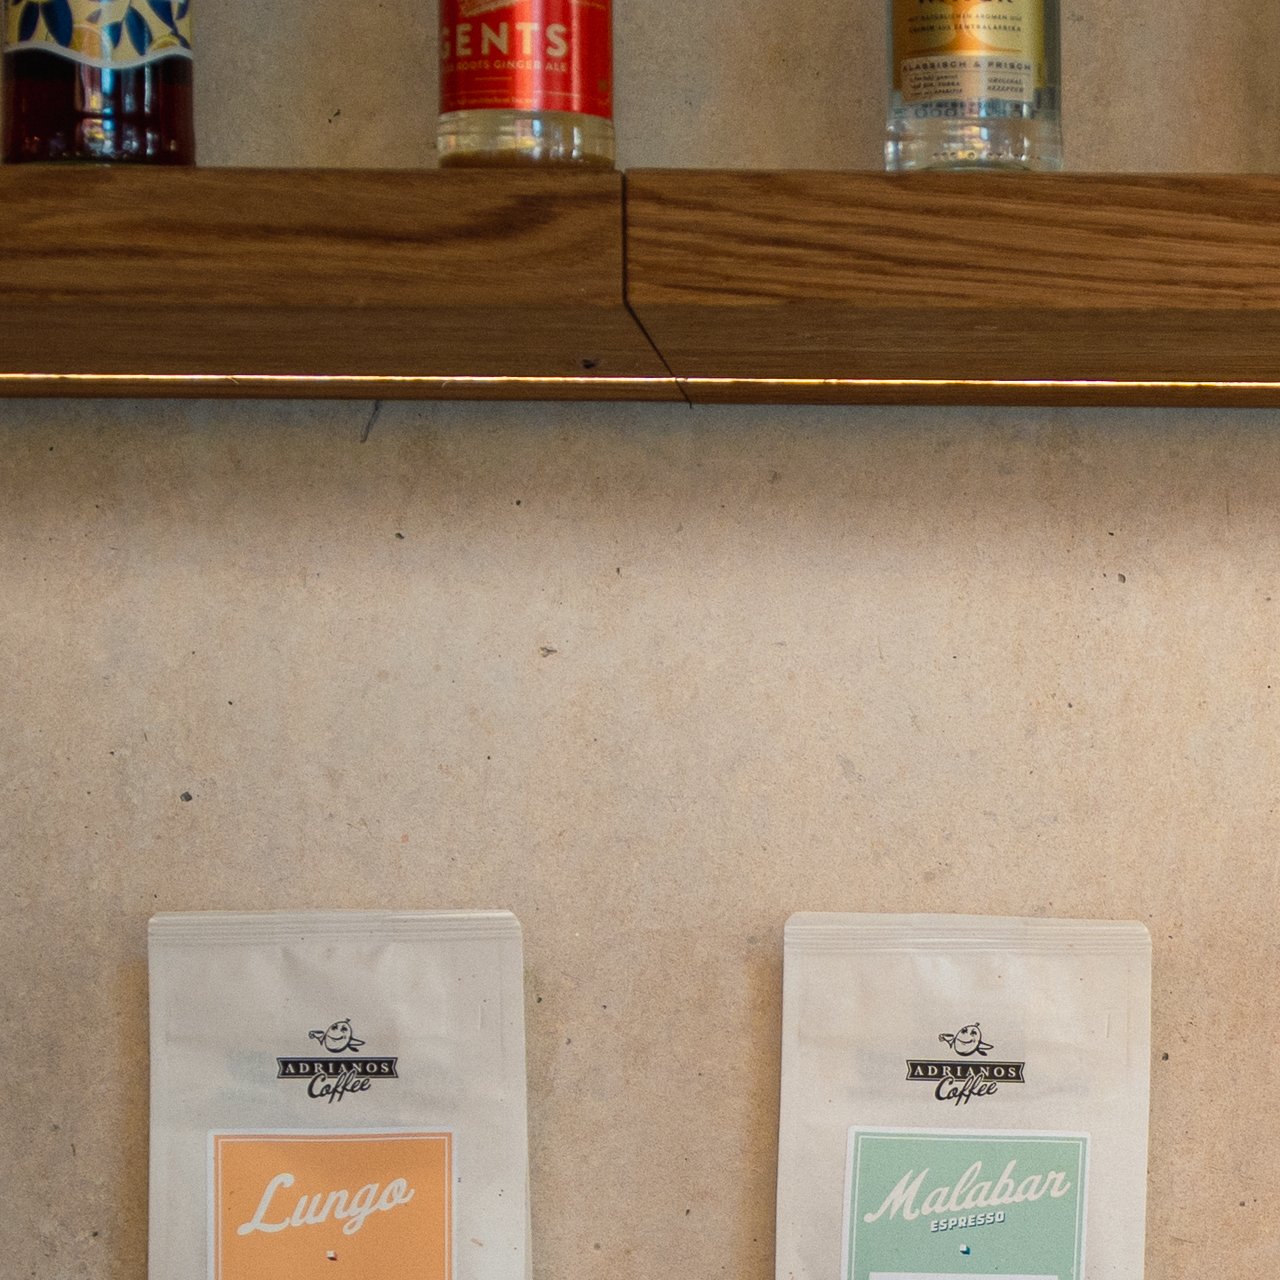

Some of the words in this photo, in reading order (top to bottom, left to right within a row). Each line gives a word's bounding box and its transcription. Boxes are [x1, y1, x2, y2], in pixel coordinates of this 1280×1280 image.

[988, 61, 1031, 70] FRISCH
[286, 1063, 389, 1073] ADRIANOS
[914, 1065, 1016, 1077] ADRIANOS
[307, 1070, 372, 1104] Coffee
[935, 1074, 998, 1106] Coffee
[236, 1173, 415, 1236] Lungo
[864, 1159, 1071, 1223] Malabar
[930, 1210, 1005, 1232] ESPRESSO
